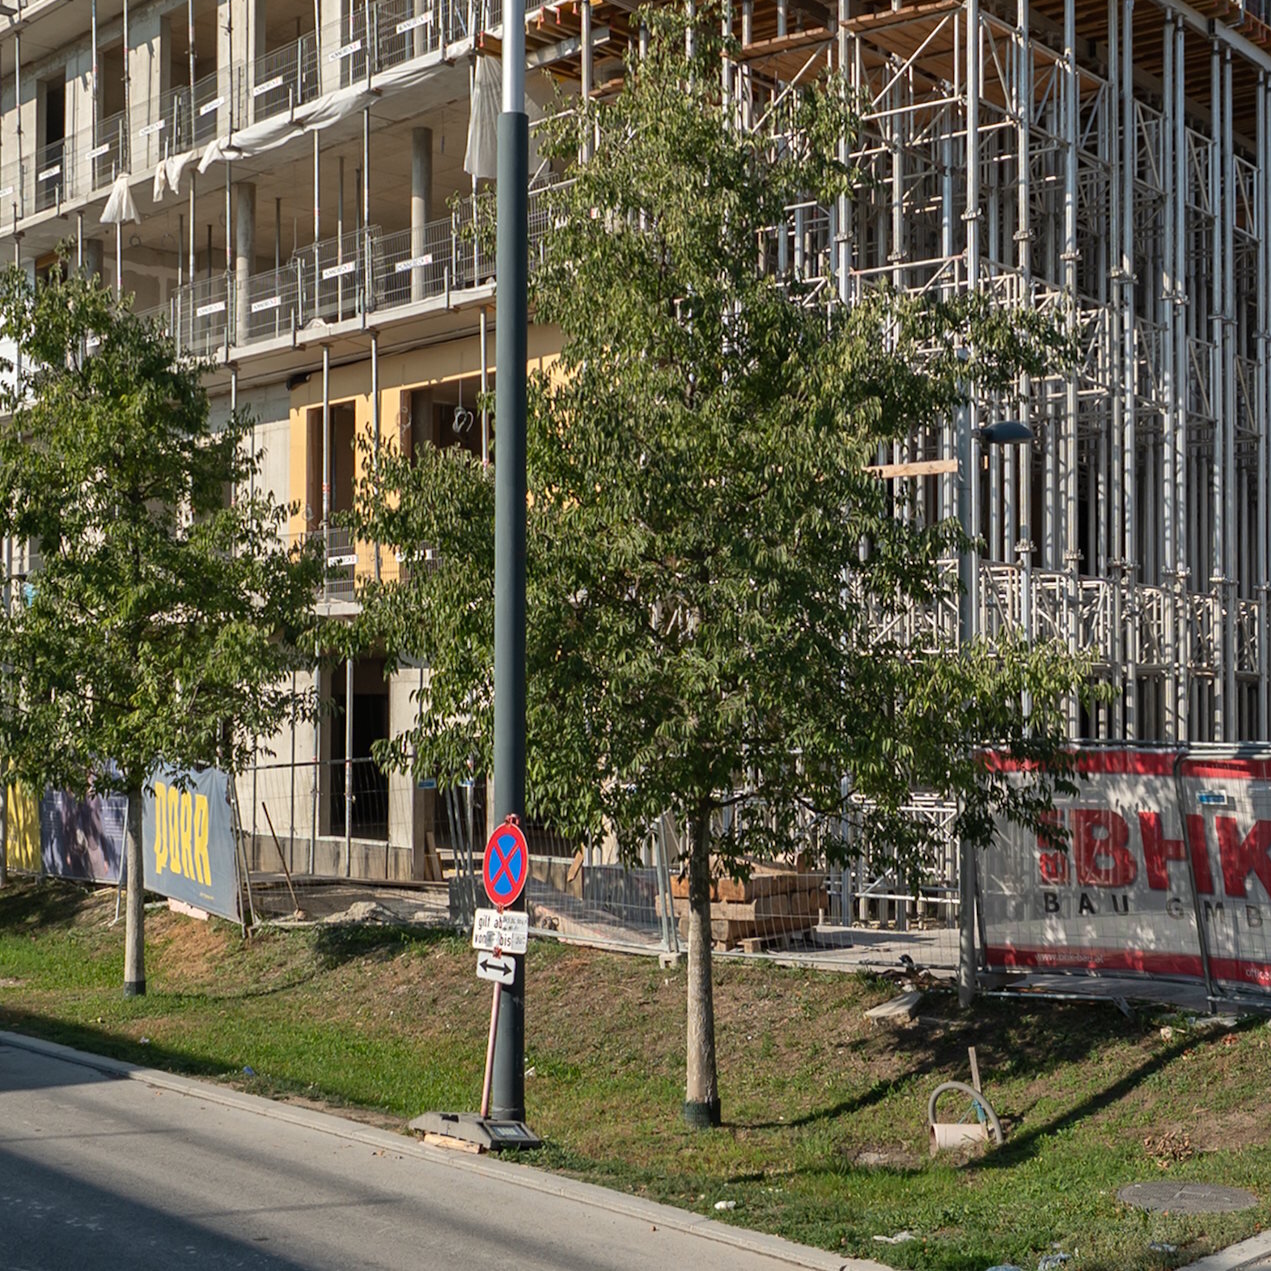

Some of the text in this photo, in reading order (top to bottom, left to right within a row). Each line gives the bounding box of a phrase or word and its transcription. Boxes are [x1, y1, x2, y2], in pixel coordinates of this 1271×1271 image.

[154, 780, 212, 887] PORR
[1044, 891, 1128, 915] BAU
[479, 915, 491, 930] gilt
[493, 916, 503, 929] ab
[499, 932, 512, 947] bis
